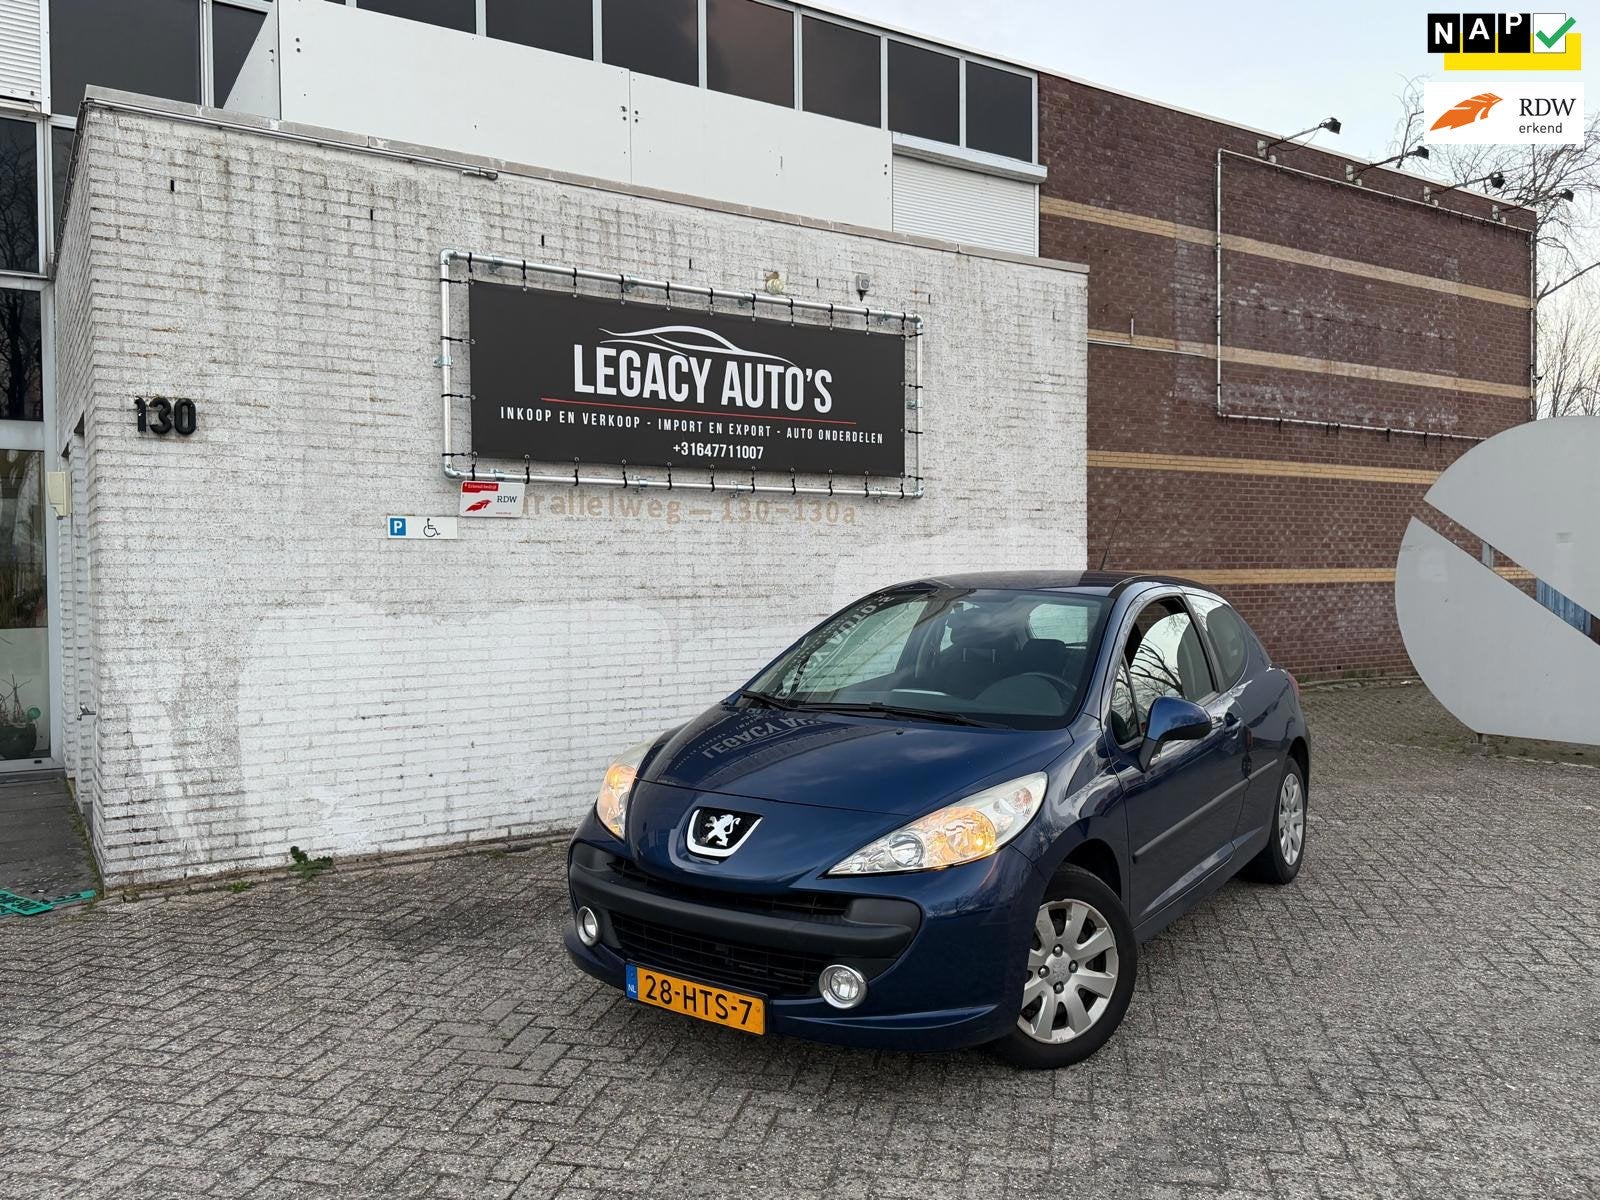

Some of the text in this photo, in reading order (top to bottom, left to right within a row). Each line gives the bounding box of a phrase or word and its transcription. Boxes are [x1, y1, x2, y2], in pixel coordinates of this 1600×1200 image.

[573, 343, 833, 414] LEGACY AUTO'S
[134, 395, 197, 436] 130
[500, 406, 552, 422] INKOOP
[559, 410, 575, 424] EN
[582, 412, 641, 428] VERKOOP
[658, 418, 703, 433] IMPORT
[708, 422, 723, 434] EN
[728, 423, 771, 437] EXPORT
[786, 427, 813, 440] AUTO
[818, 429, 883, 444] ONDERDELEN
[672, 441, 764, 460] +31647711007
[496, 495, 518, 503] RDW
[393, 520, 403, 534] P
[627, 984, 637, 993] NL
[645, 974, 753, 1025] 28-HTS-7
